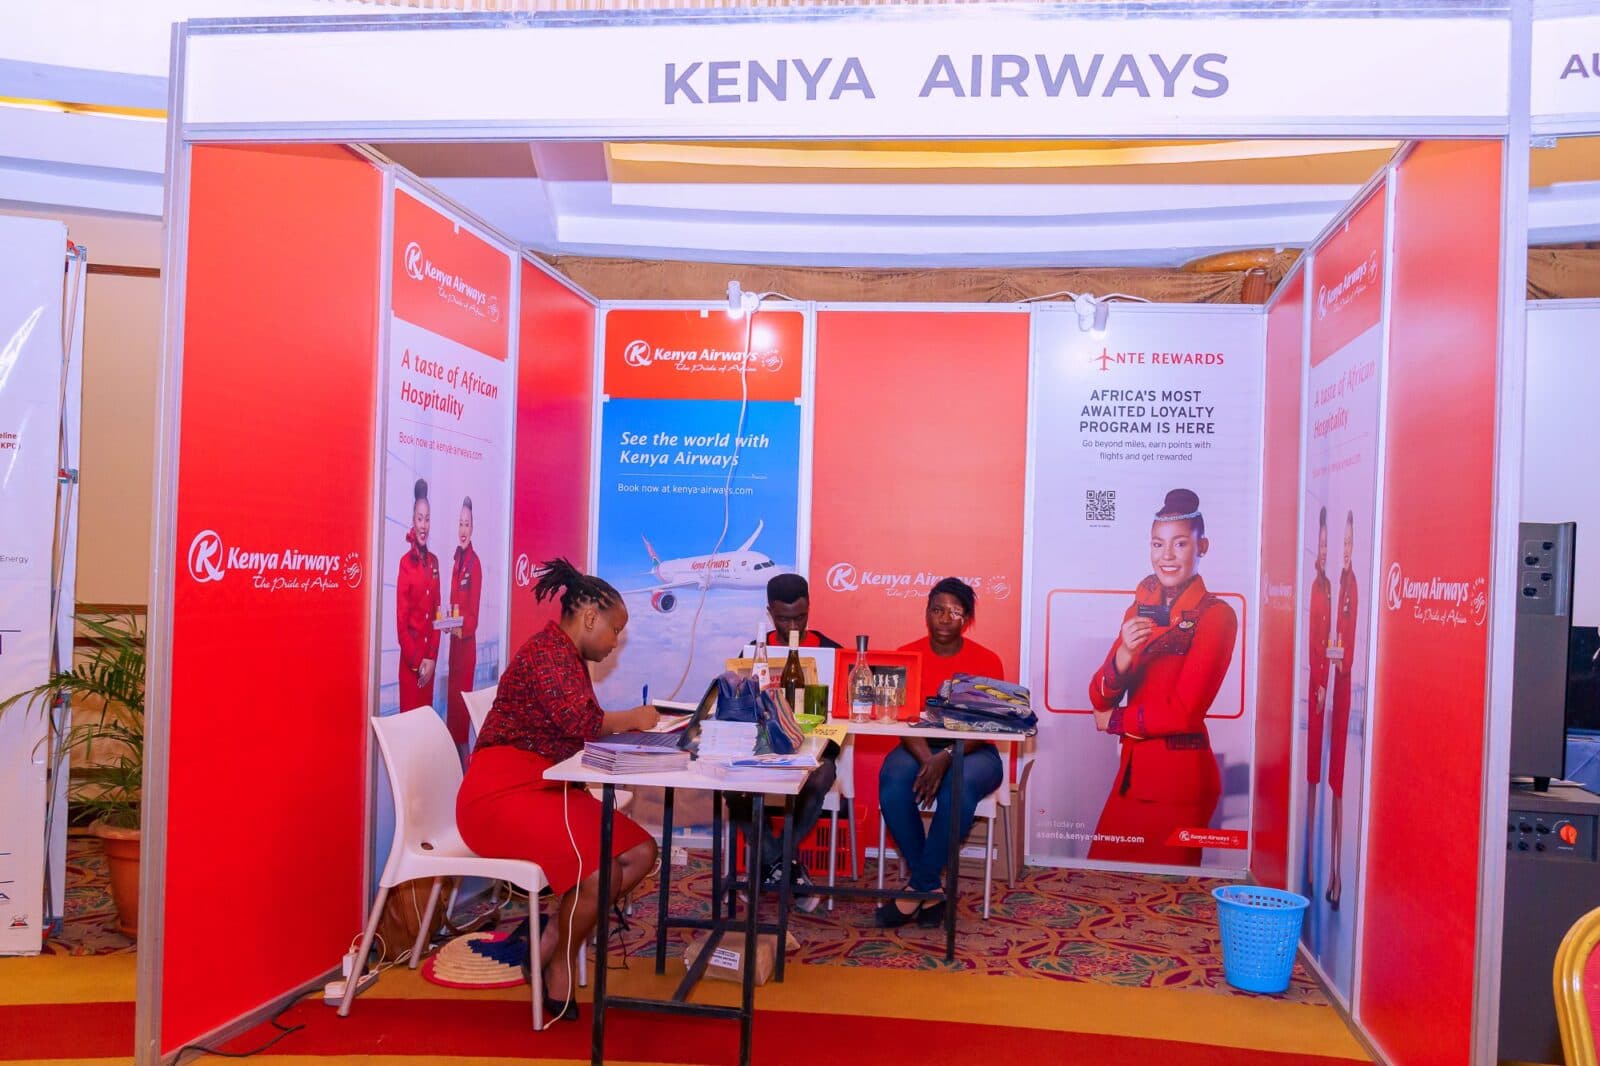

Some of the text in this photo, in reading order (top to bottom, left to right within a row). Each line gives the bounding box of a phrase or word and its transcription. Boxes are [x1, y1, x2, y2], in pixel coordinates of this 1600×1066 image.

[665, 53, 1230, 104] KENYA AIRWAYS
[425, 260, 486, 305] Kenya Airways
[654, 348, 758, 365] Kenya Airways
[1152, 353, 1224, 366] REWARDS
[401, 349, 498, 399] A taste of African
[401, 381, 464, 421] Hospitality
[1090, 389, 1201, 402] AFRICA'S MOST
[1081, 405, 1215, 418] AWAITED LOYALTY
[1080, 421, 1215, 434] PROGRAM IS HERE
[399, 431, 414, 446] Book
[415, 437, 428, 448] now
[620, 431, 770, 448] See the world with
[1082, 440, 1093, 448] Go
[1094, 439, 1123, 450] beyond
[1125, 439, 1147, 449] miles,
[1168, 440, 1192, 450] points
[1194, 440, 1211, 449] with
[619, 450, 739, 469] Kenya Airways
[1099, 452, 1193, 463] flights and get rewarded
[618, 483, 753, 497] Book now at kenya-airways.com
[227, 547, 279, 574] Kenya
[281, 549, 340, 575] Airways
[253, 576, 270, 589] The
[270, 577, 300, 593] Pride
[301, 579, 310, 592] of
[861, 571, 911, 588] Kenya
[1403, 577, 1429, 605] Kenya
[1429, 577, 1469, 607] Airways
